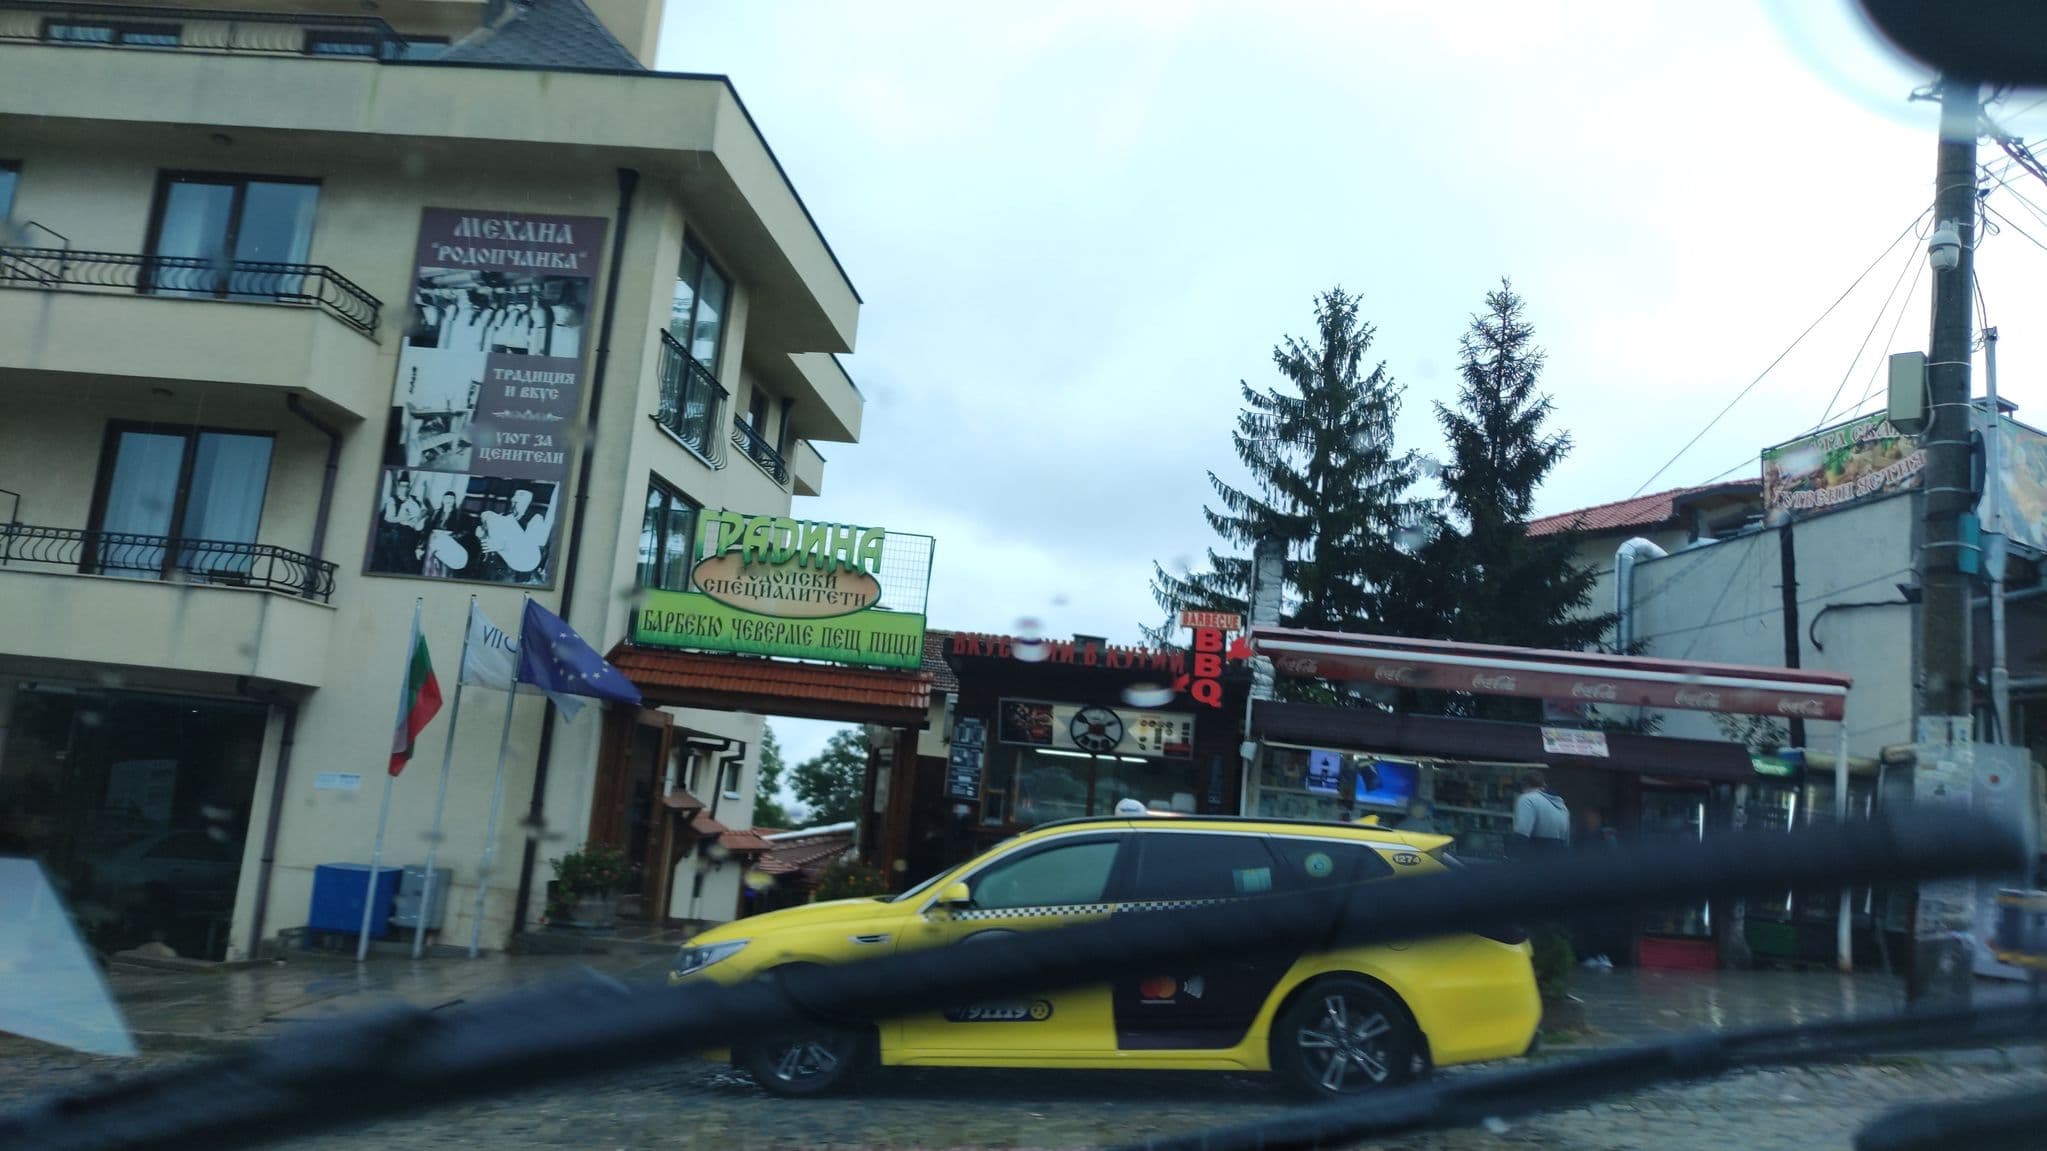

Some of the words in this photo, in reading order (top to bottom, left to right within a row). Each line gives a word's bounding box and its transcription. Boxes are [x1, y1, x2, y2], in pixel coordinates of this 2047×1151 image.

[453, 216, 575, 244] МЕХАНА
[493, 368, 576, 385] ТРАДИЦИЯ
[504, 385, 516, 397] И
[520, 386, 559, 402] ВКУС
[496, 431, 530, 446] УЮТ
[533, 434, 553, 447] ЗА
[480, 447, 564, 464] ЦЕНИТЕЛИ
[694, 509, 886, 576] ГРАДИНА
[703, 577, 866, 608] СПЕЦИАЛИТЕТИ
[1181, 610, 1240, 631] BARBECUE
[643, 608, 723, 638] БАРБЕКЮ
[731, 617, 813, 647] ЧЕВЕРМЕ
[820, 626, 861, 656] ПЕЩ
[869, 630, 919, 658] ПИЦИ
[1191, 627, 1223, 709] BBQ
[1393, 854, 1420, 865] 1274
